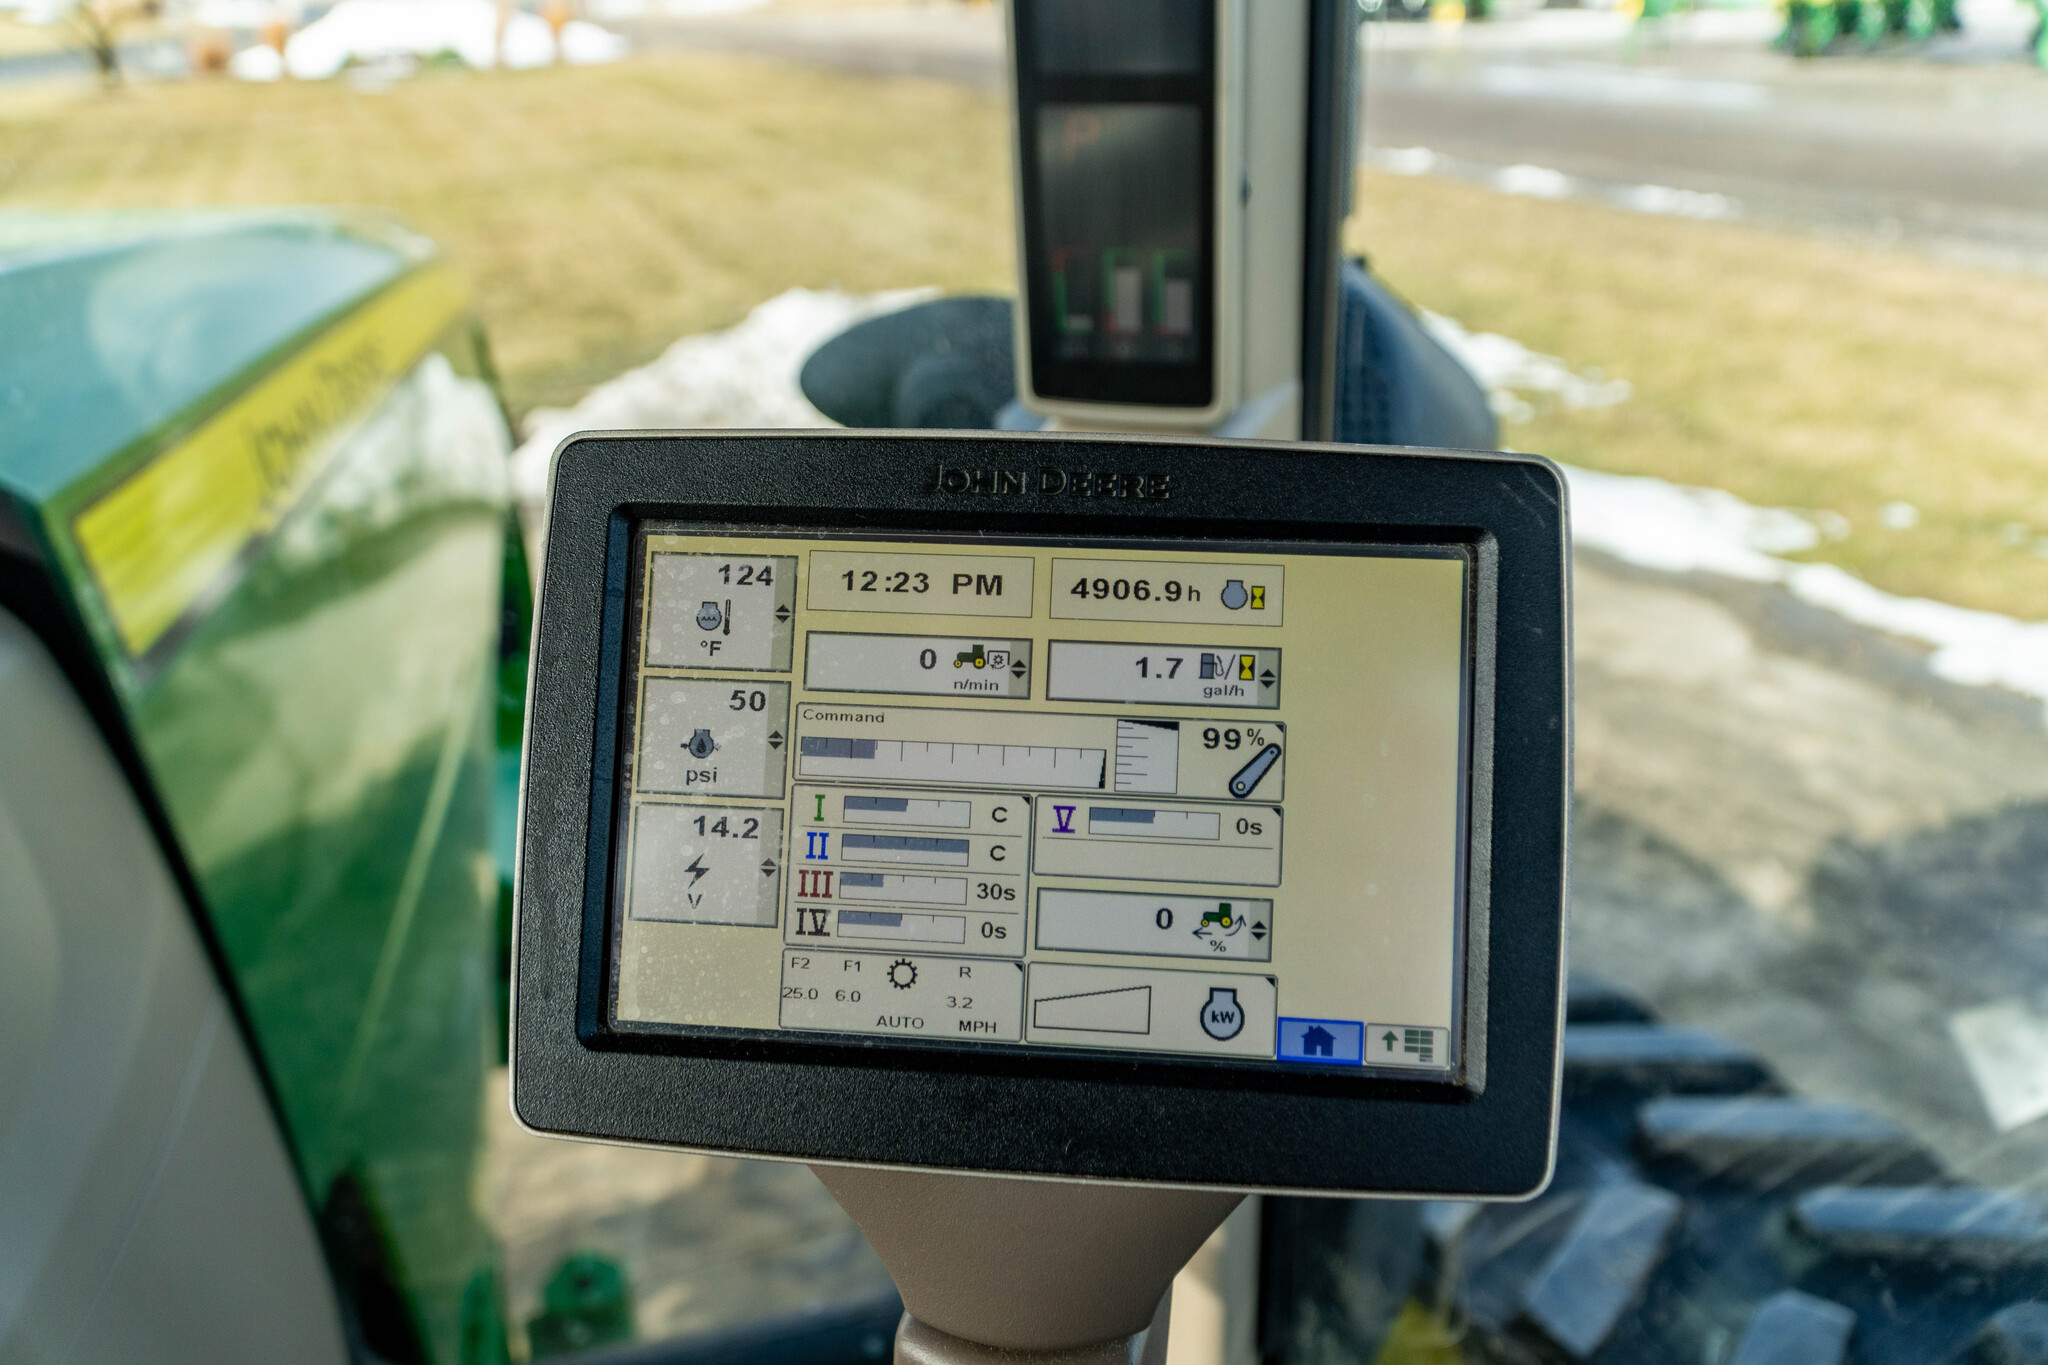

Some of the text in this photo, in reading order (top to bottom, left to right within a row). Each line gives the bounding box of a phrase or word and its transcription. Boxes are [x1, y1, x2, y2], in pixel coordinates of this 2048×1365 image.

[922, 463, 1170, 499] JOHN DEERE
[718, 564, 774, 587] 124
[841, 570, 1004, 596] 12:23 PM
[920, 648, 937, 670] 0
[1135, 656, 1184, 679] 1.7
[953, 679, 1000, 691] n/min
[1203, 684, 1245, 699] gal/h
[729, 690, 766, 712] 50
[802, 708, 885, 724] Command
[686, 767, 718, 785] psi
[813, 794, 826, 822] I
[991, 807, 1008, 823] C
[1052, 805, 1076, 833] V
[693, 815, 760, 840] 14.2
[1236, 817, 1263, 835] 0s
[805, 832, 830, 860] II
[989, 845, 1006, 862] C
[797, 869, 834, 898] III
[976, 883, 1016, 901] 30s
[687, 893, 702, 909] V
[795, 908, 831, 936] IV
[981, 921, 1007, 939] 0s
[1156, 908, 1174, 930] 0
[791, 957, 972, 979] F2 F1 R
[782, 987, 974, 1009] 25.0 6.0 3.2
[876, 1016, 997, 1033] AUTO MPH
[1211, 1011, 1235, 1023] kW
